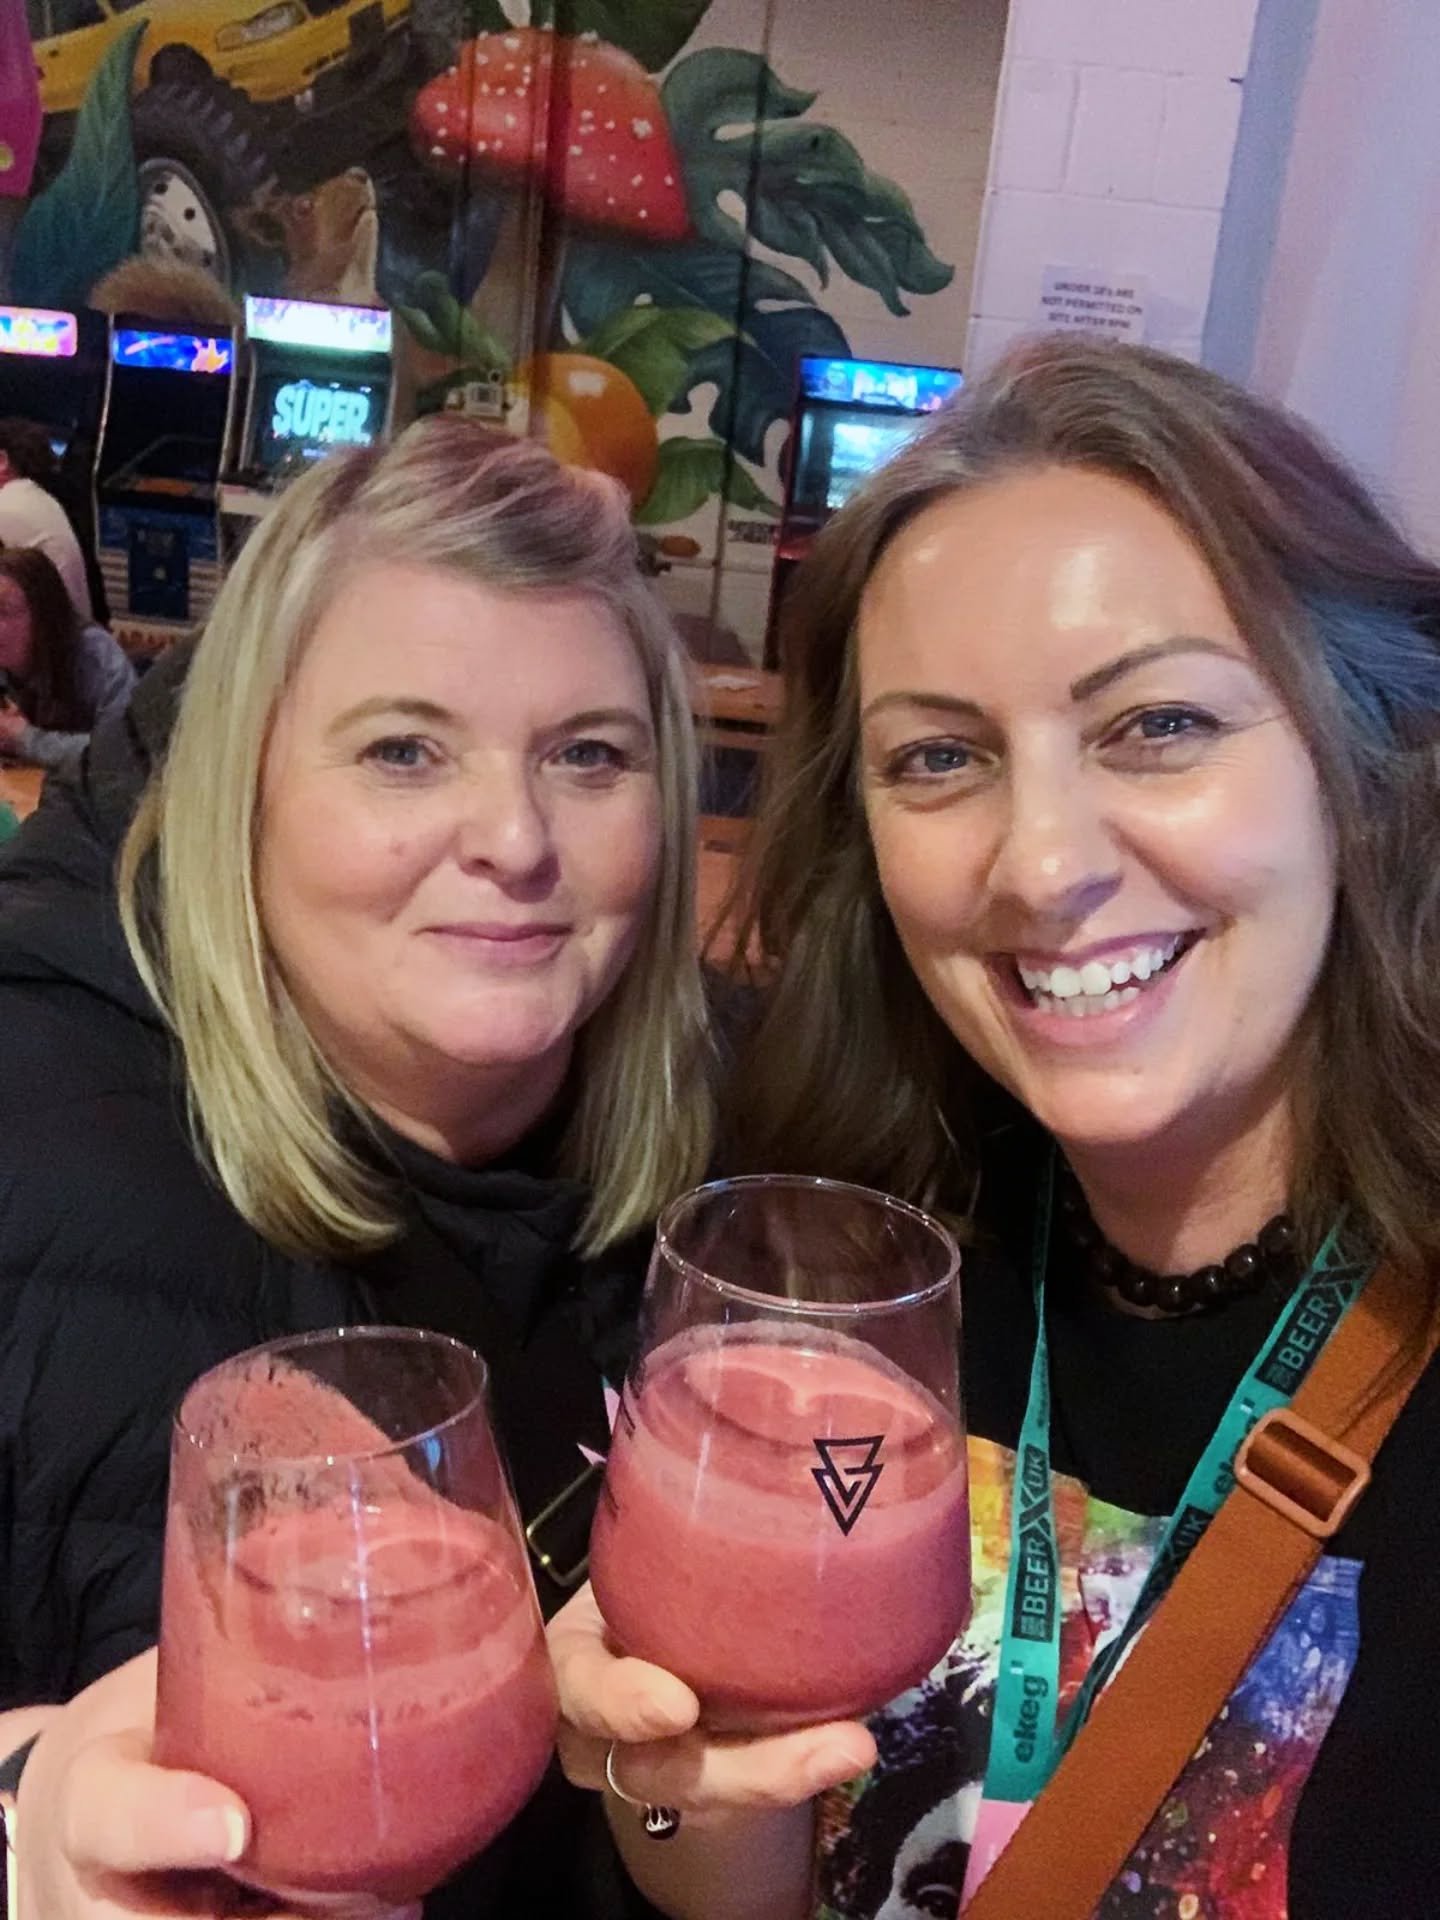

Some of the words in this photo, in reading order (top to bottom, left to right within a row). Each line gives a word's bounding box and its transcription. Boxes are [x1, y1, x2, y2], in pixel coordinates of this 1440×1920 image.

[1041, 296, 1063, 306] NOT
[1065, 298, 1125, 314] PERMITTED
[1054, 282, 1090, 293] UNDER
[272, 383, 371, 442] SUPER
[1023, 1450, 1045, 1488] UK
[1014, 1674, 1049, 1764] ekeg
